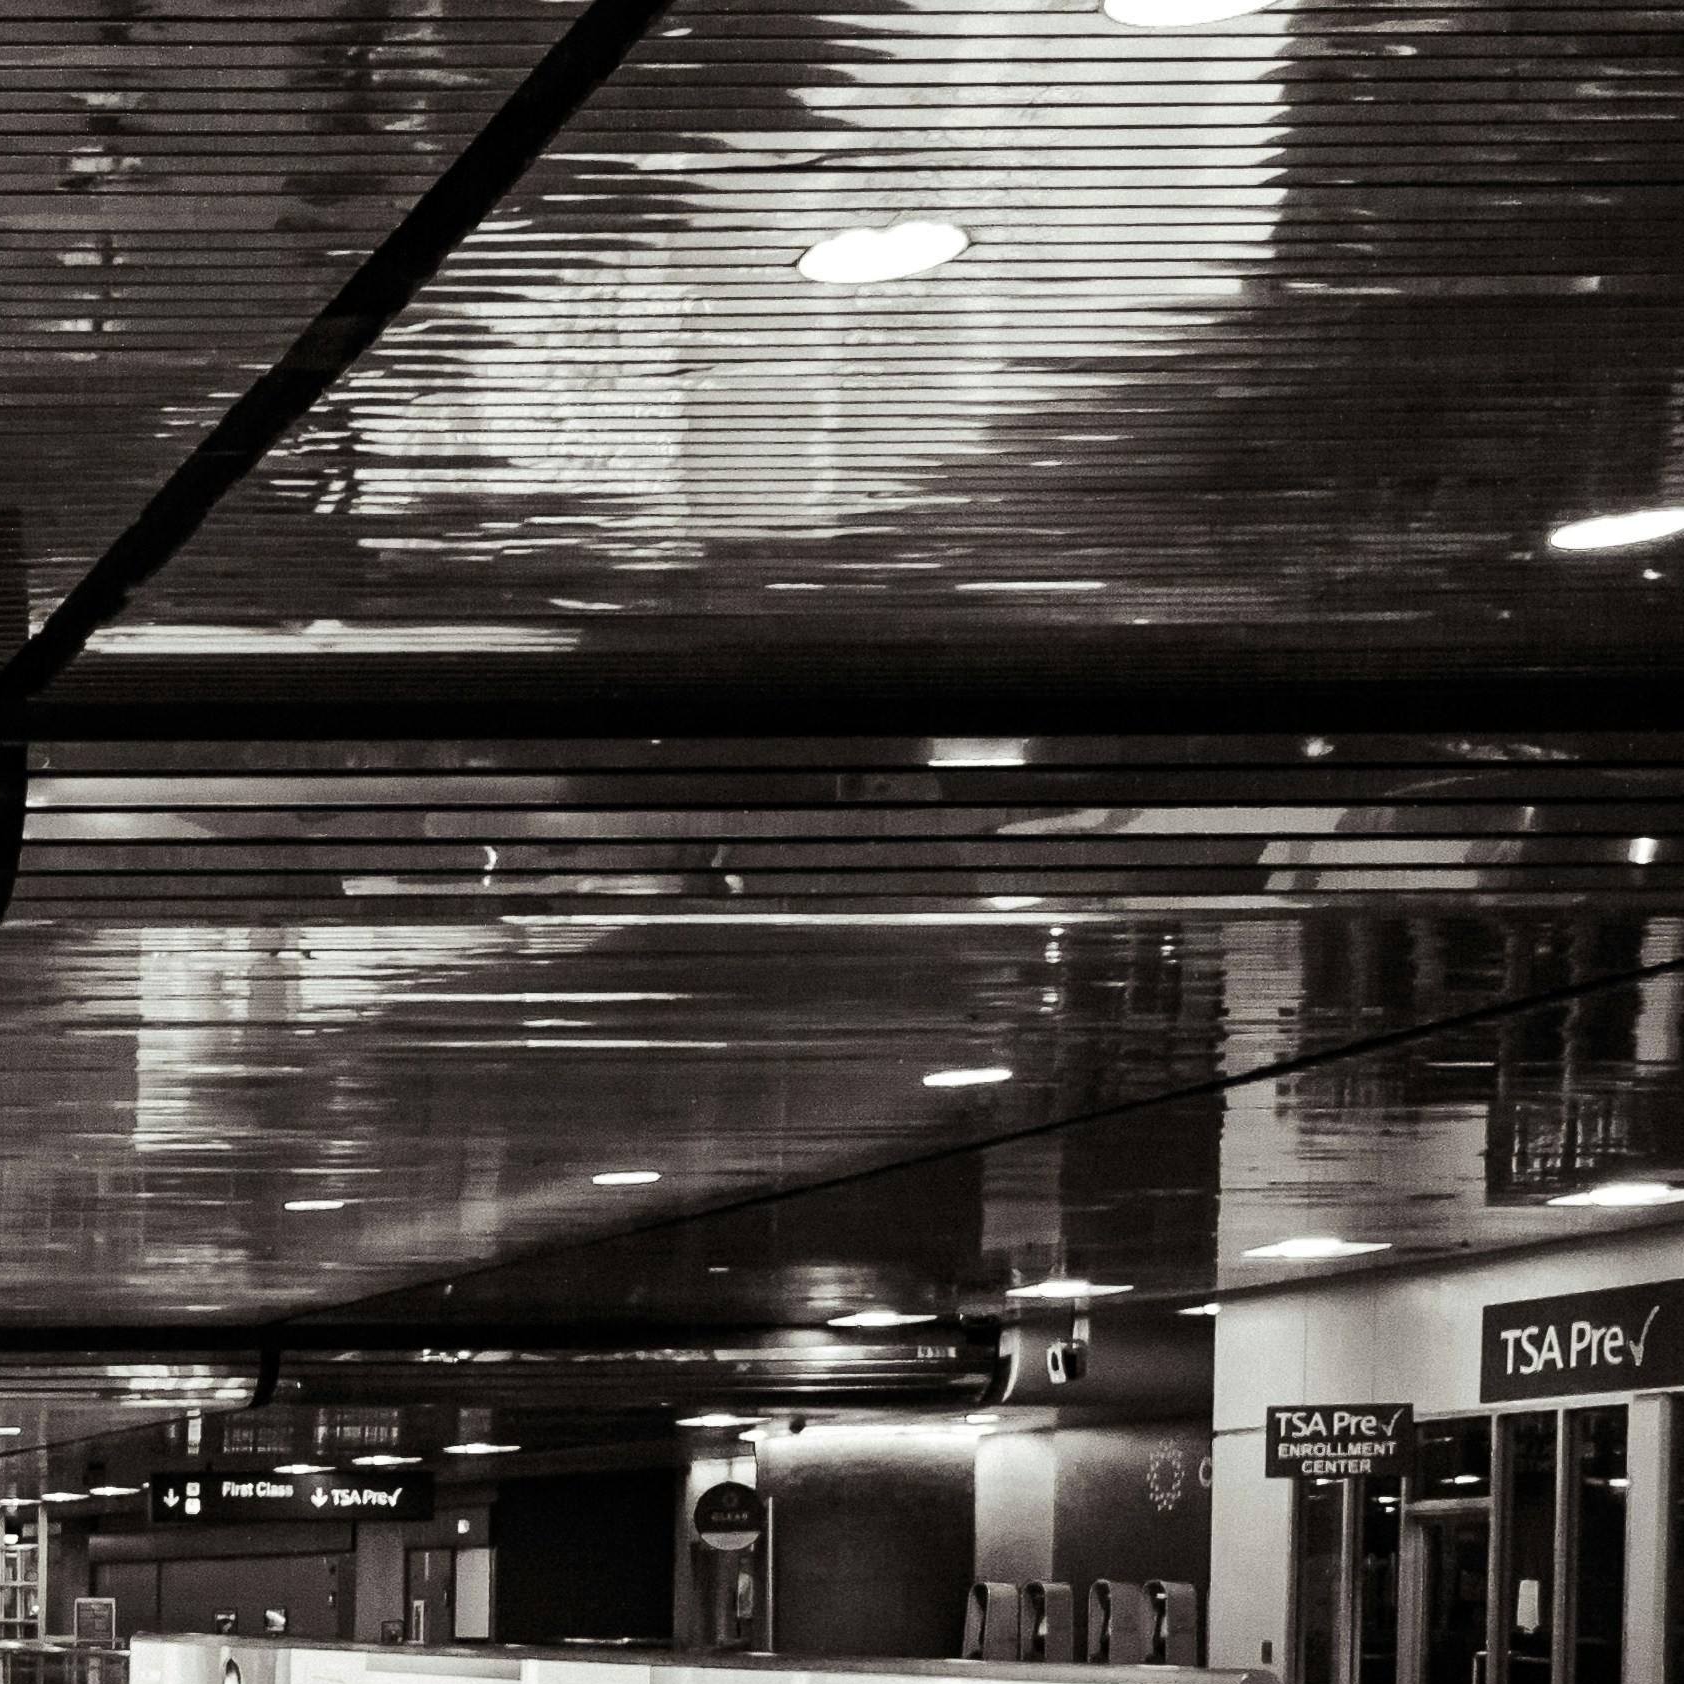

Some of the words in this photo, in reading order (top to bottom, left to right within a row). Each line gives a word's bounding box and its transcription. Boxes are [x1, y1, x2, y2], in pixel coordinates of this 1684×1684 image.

[1500, 1325, 1564, 1376] TSA
[1569, 1319, 1624, 1368] Pre
[1274, 1410, 1328, 1438] TSA
[1333, 1412, 1379, 1438] Pre
[1277, 1440, 1397, 1458] ENROLLMENT
[1301, 1457, 1372, 1475] CENTER
[221, 1481, 254, 1498] First
[255, 1481, 294, 1498] Class
[330, 1488, 362, 1507] TSA
